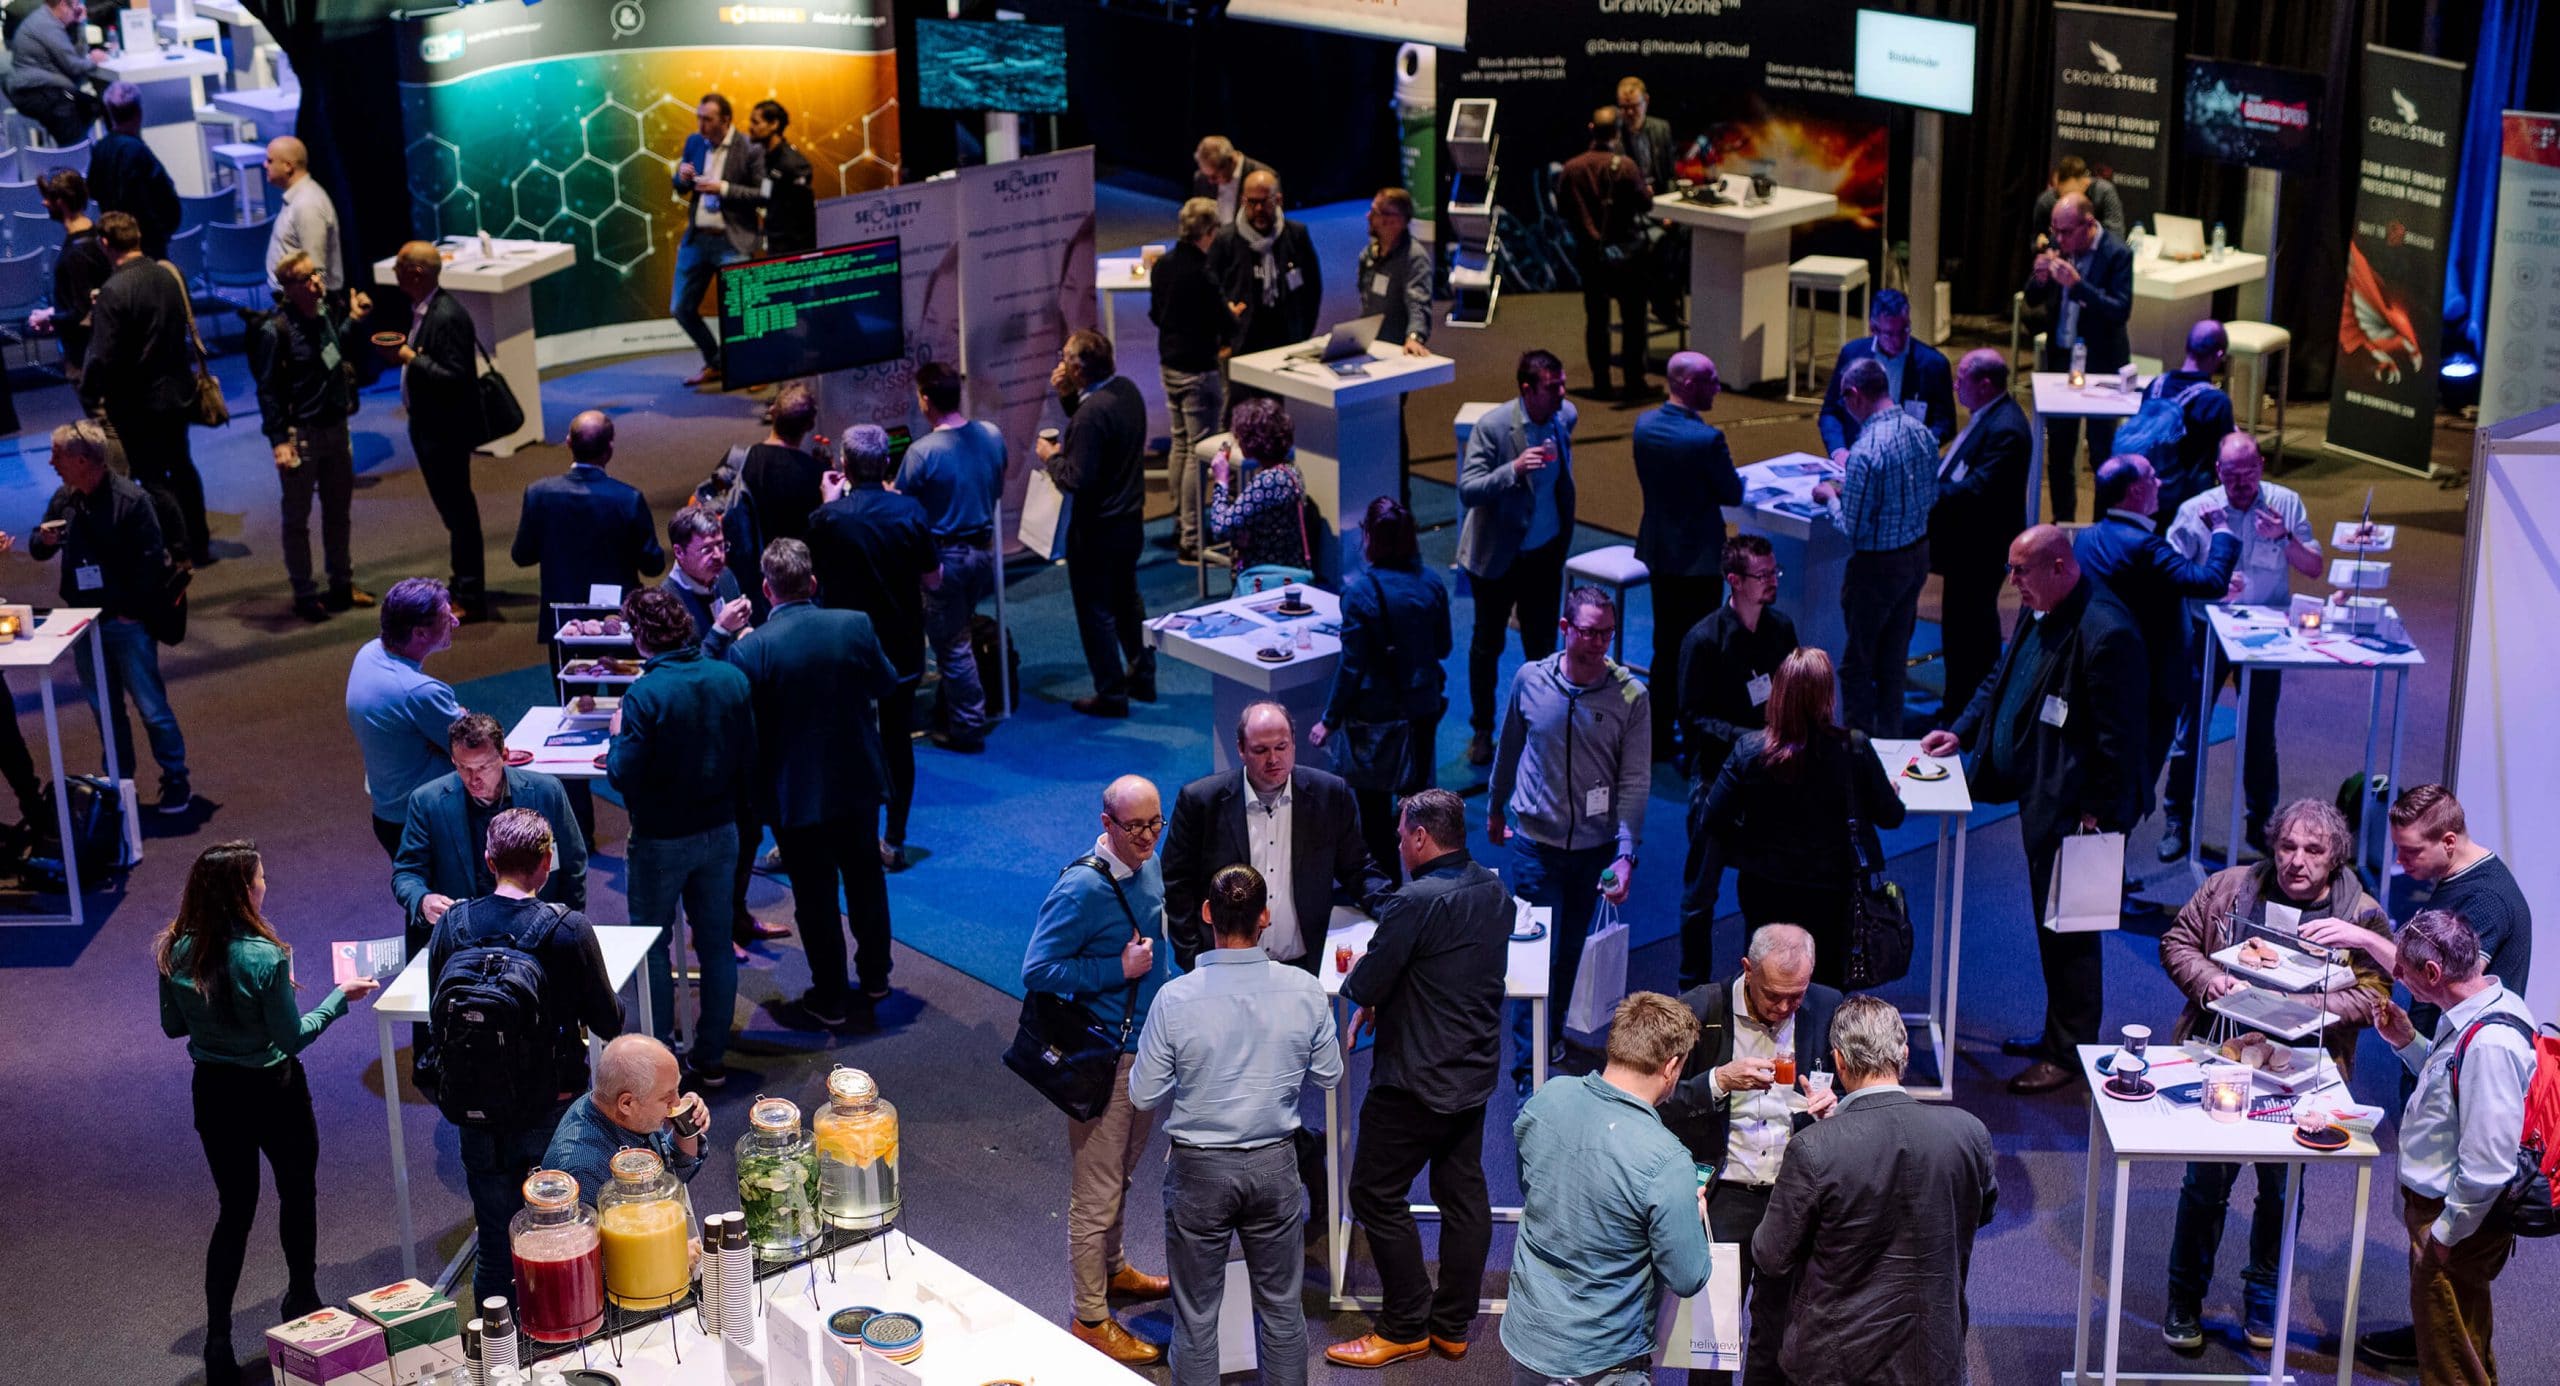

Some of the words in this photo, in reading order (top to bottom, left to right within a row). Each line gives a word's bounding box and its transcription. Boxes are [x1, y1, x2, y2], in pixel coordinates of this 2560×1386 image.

[1586, 39, 1640, 56] @Device
[1641, 40, 1703, 56] @Network
[1704, 42, 1750, 59] @Cloud
[2062, 69, 2158, 94] CROWDSTRIKE
[2368, 116, 2446, 148] CROWDSTRIKE
[993, 169, 1060, 194] SECURITY
[855, 200, 921, 225] SECURITY
[1689, 1338, 1737, 1351] heliview
